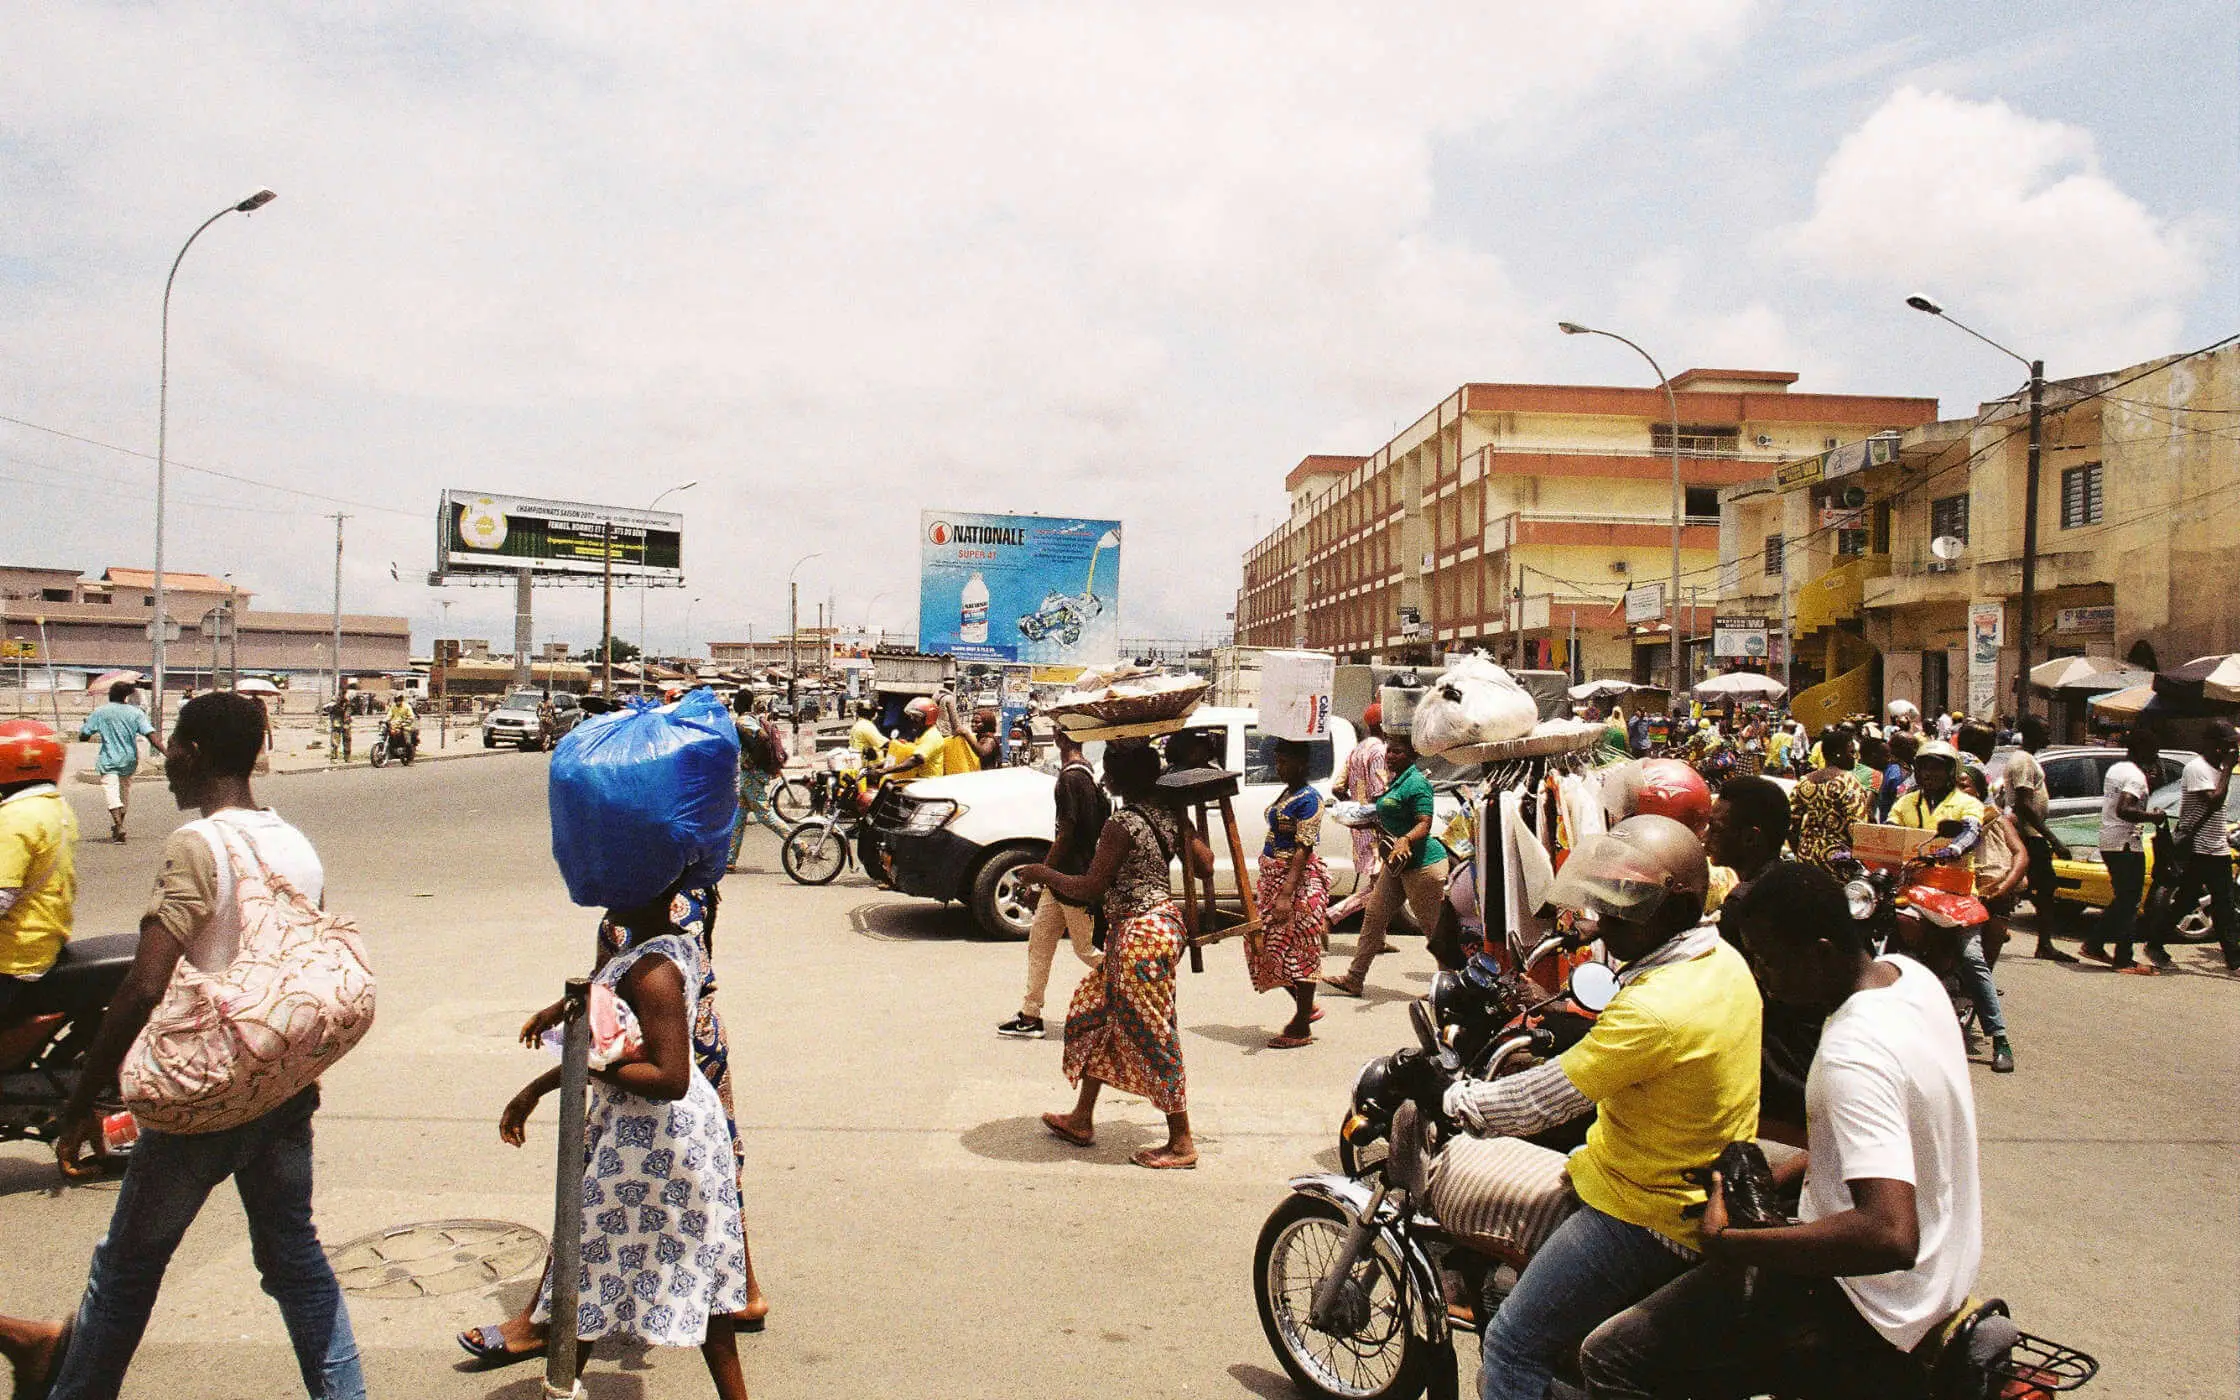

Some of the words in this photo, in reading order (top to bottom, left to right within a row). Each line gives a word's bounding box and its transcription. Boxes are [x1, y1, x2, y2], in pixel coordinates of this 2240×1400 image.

[516, 505, 559, 516] CHAMPIONNATS
[560, 509, 580, 518] SAISON
[953, 525, 1025, 546] NATIONALE
[958, 549, 985, 559] SUPER
